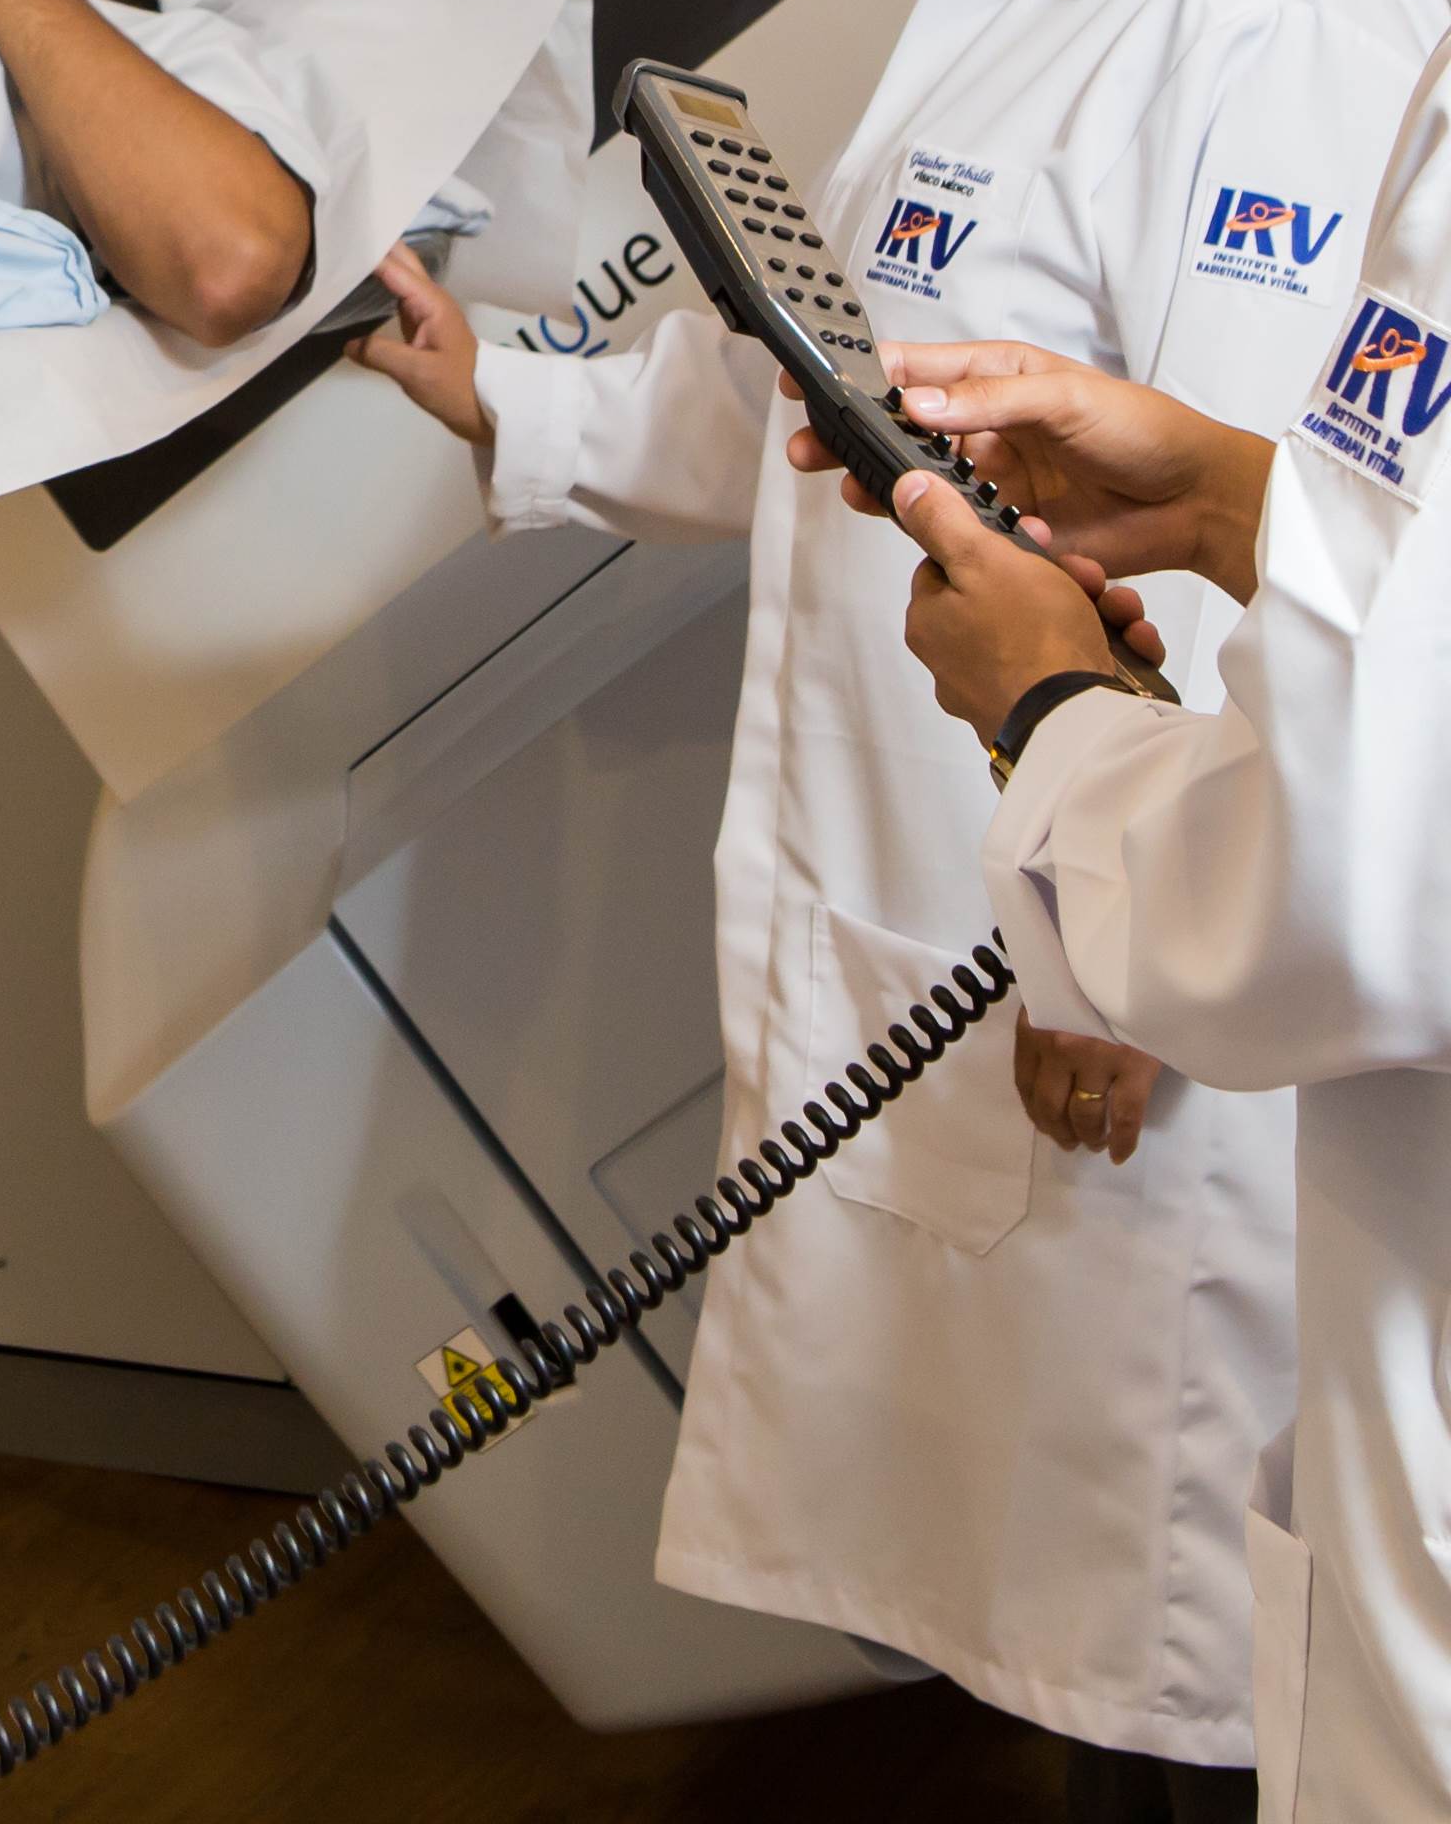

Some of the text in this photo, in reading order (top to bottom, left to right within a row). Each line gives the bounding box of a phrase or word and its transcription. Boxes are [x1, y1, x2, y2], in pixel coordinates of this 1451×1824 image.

[874, 197, 978, 271] IRV
[1203, 186, 1344, 266] IRV
[1213, 251, 1278, 273] INSTITUTO
[1325, 297, 1451, 437] IRV
